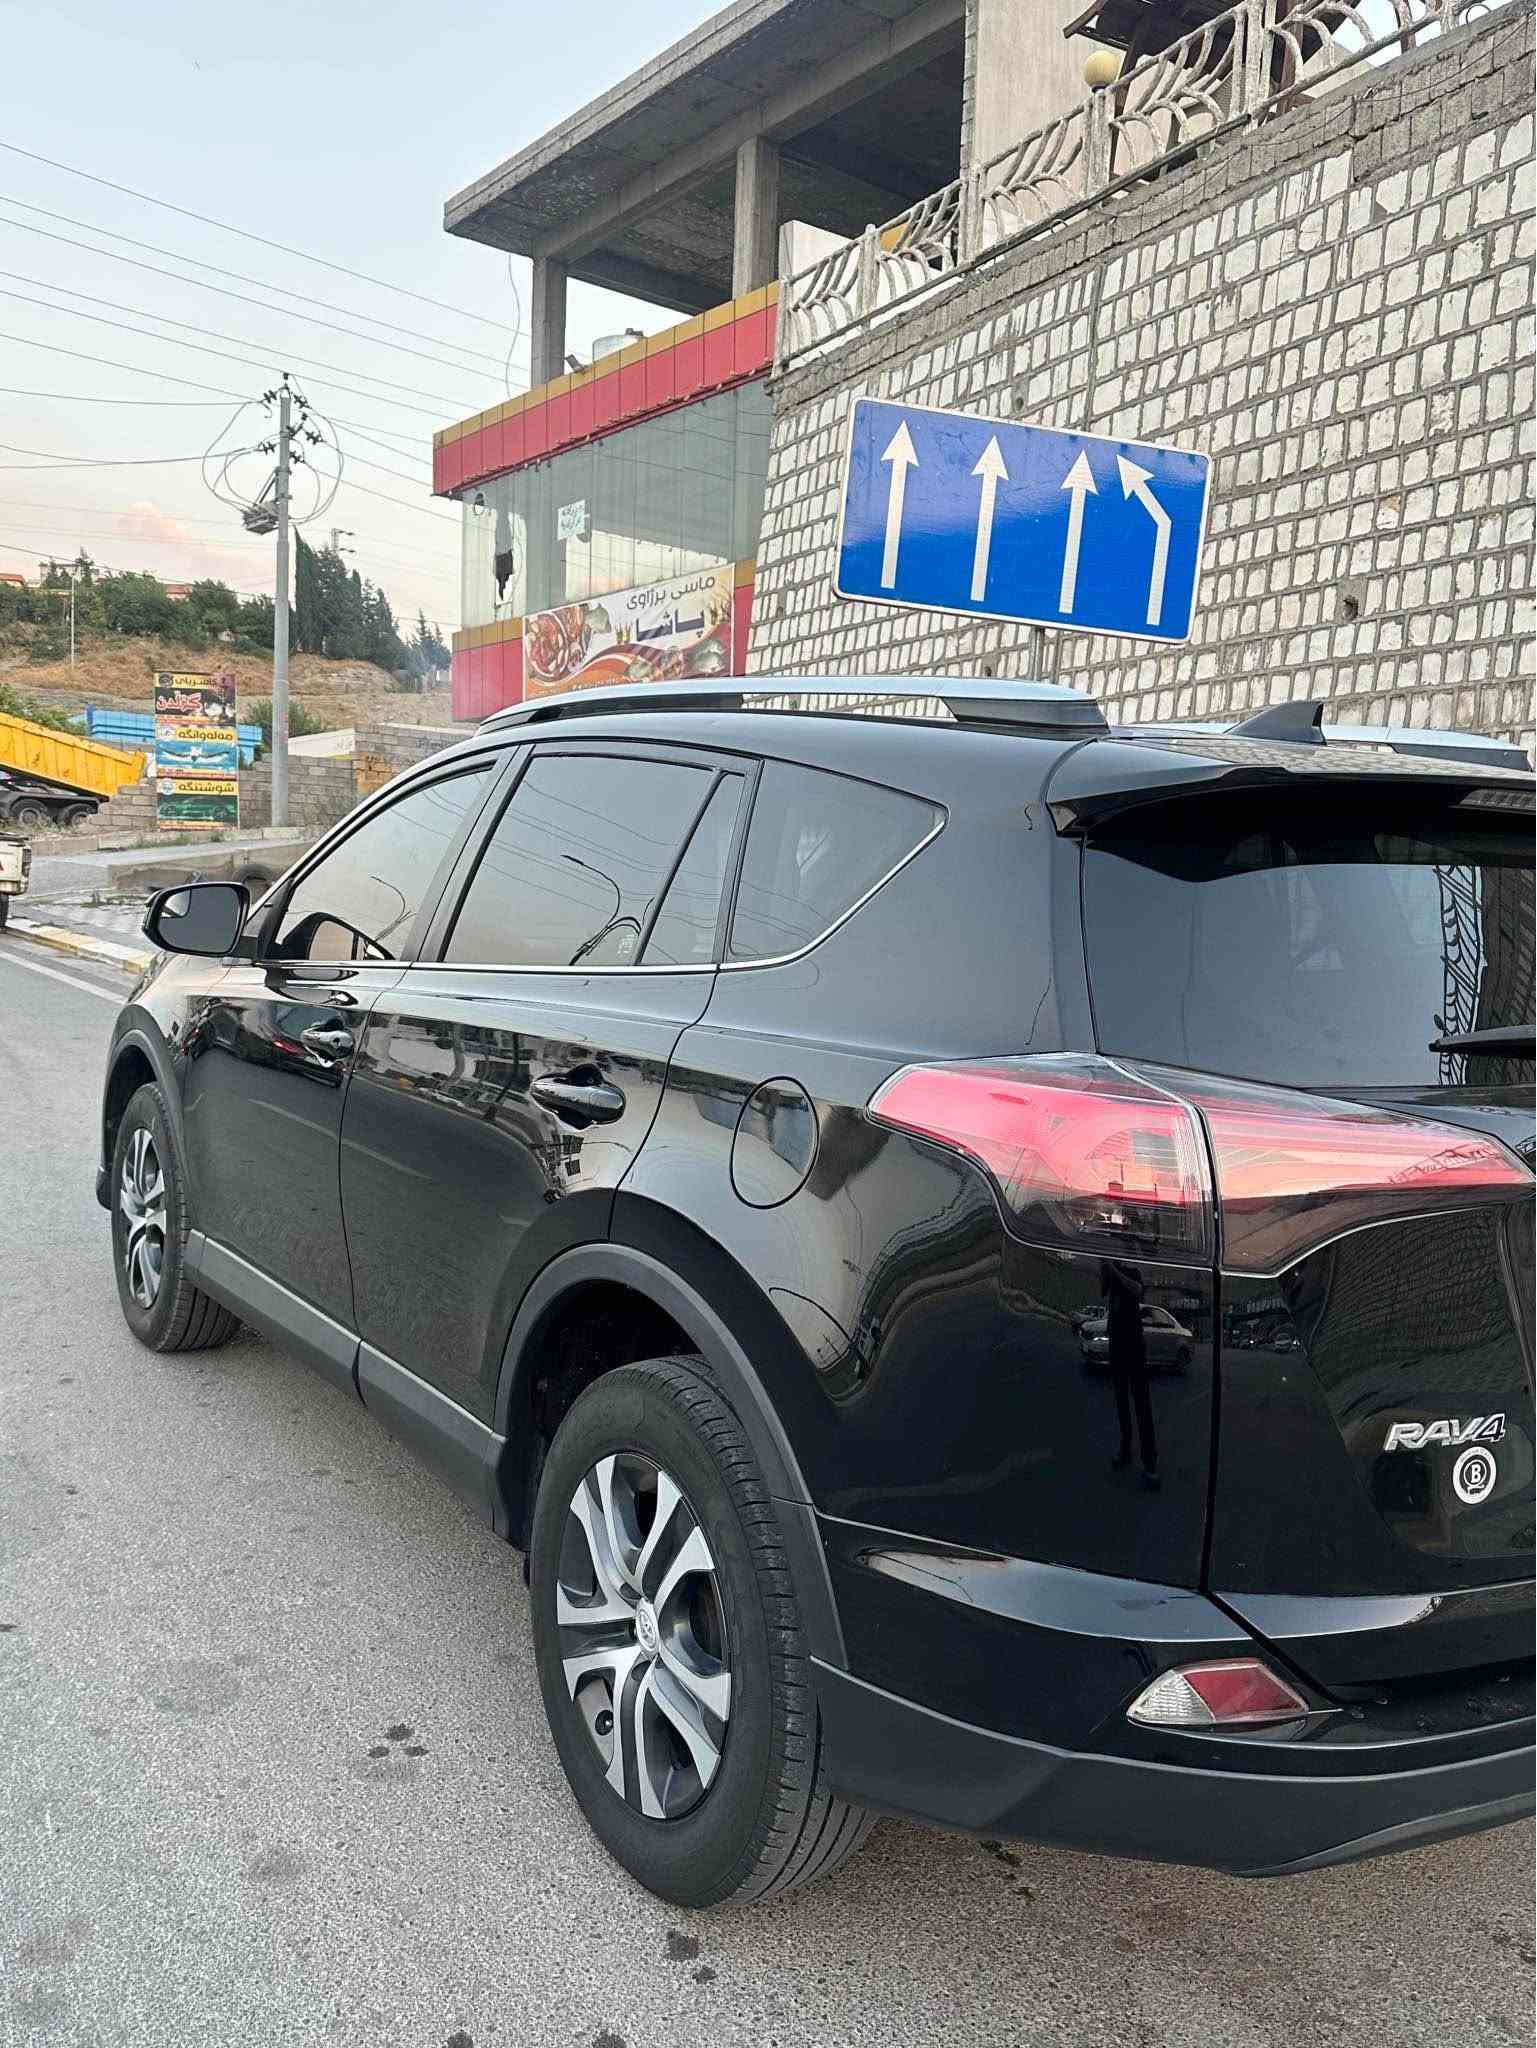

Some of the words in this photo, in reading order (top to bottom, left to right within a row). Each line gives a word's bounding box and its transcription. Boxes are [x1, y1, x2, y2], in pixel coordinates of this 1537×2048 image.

[636, 608, 704, 641] پاشا
[1384, 1413, 1506, 1451] RAV4
[1471, 1464, 1481, 1483] B
